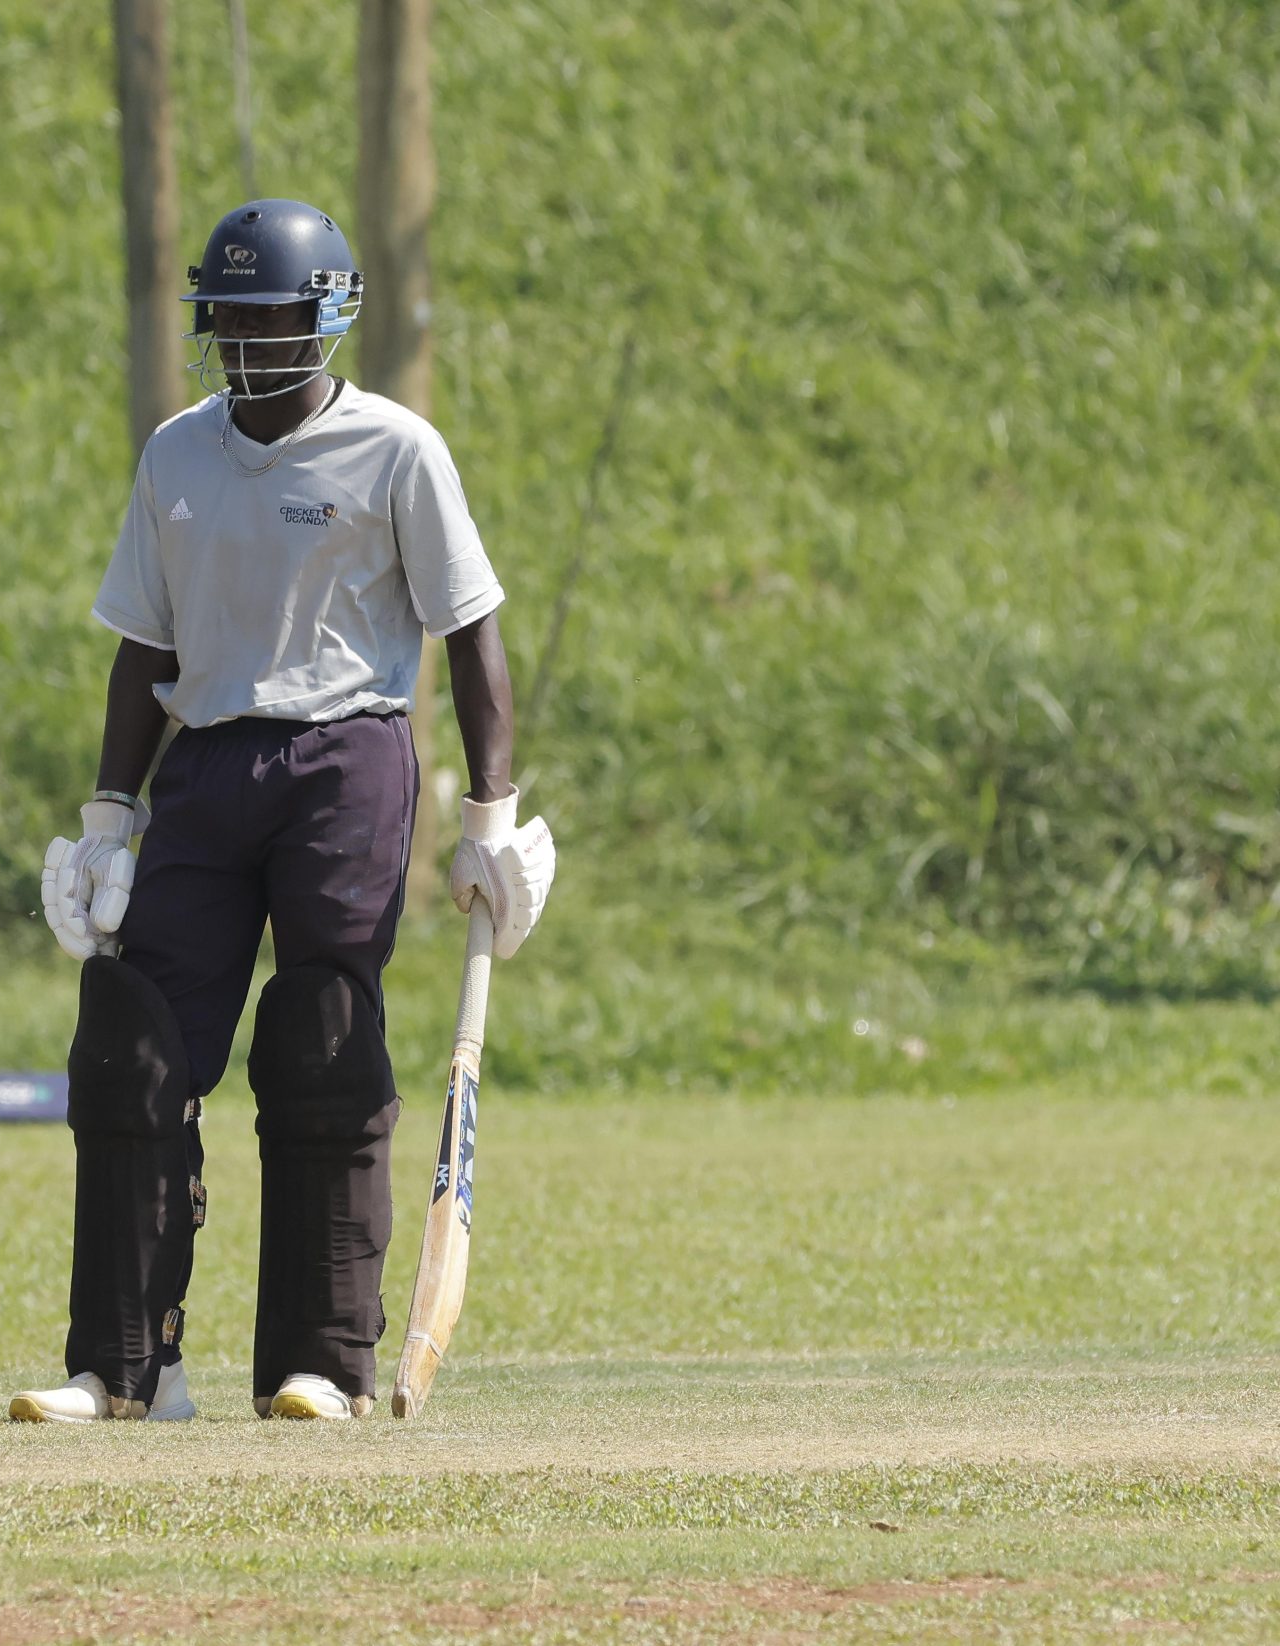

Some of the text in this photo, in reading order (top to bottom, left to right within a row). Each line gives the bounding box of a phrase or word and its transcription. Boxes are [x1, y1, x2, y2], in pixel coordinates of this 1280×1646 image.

[169, 511, 193, 521] adidas
[279, 506, 322, 518] CRICKET
[285, 514, 329, 527] UGANDA
[436, 1163, 450, 1188] NK
